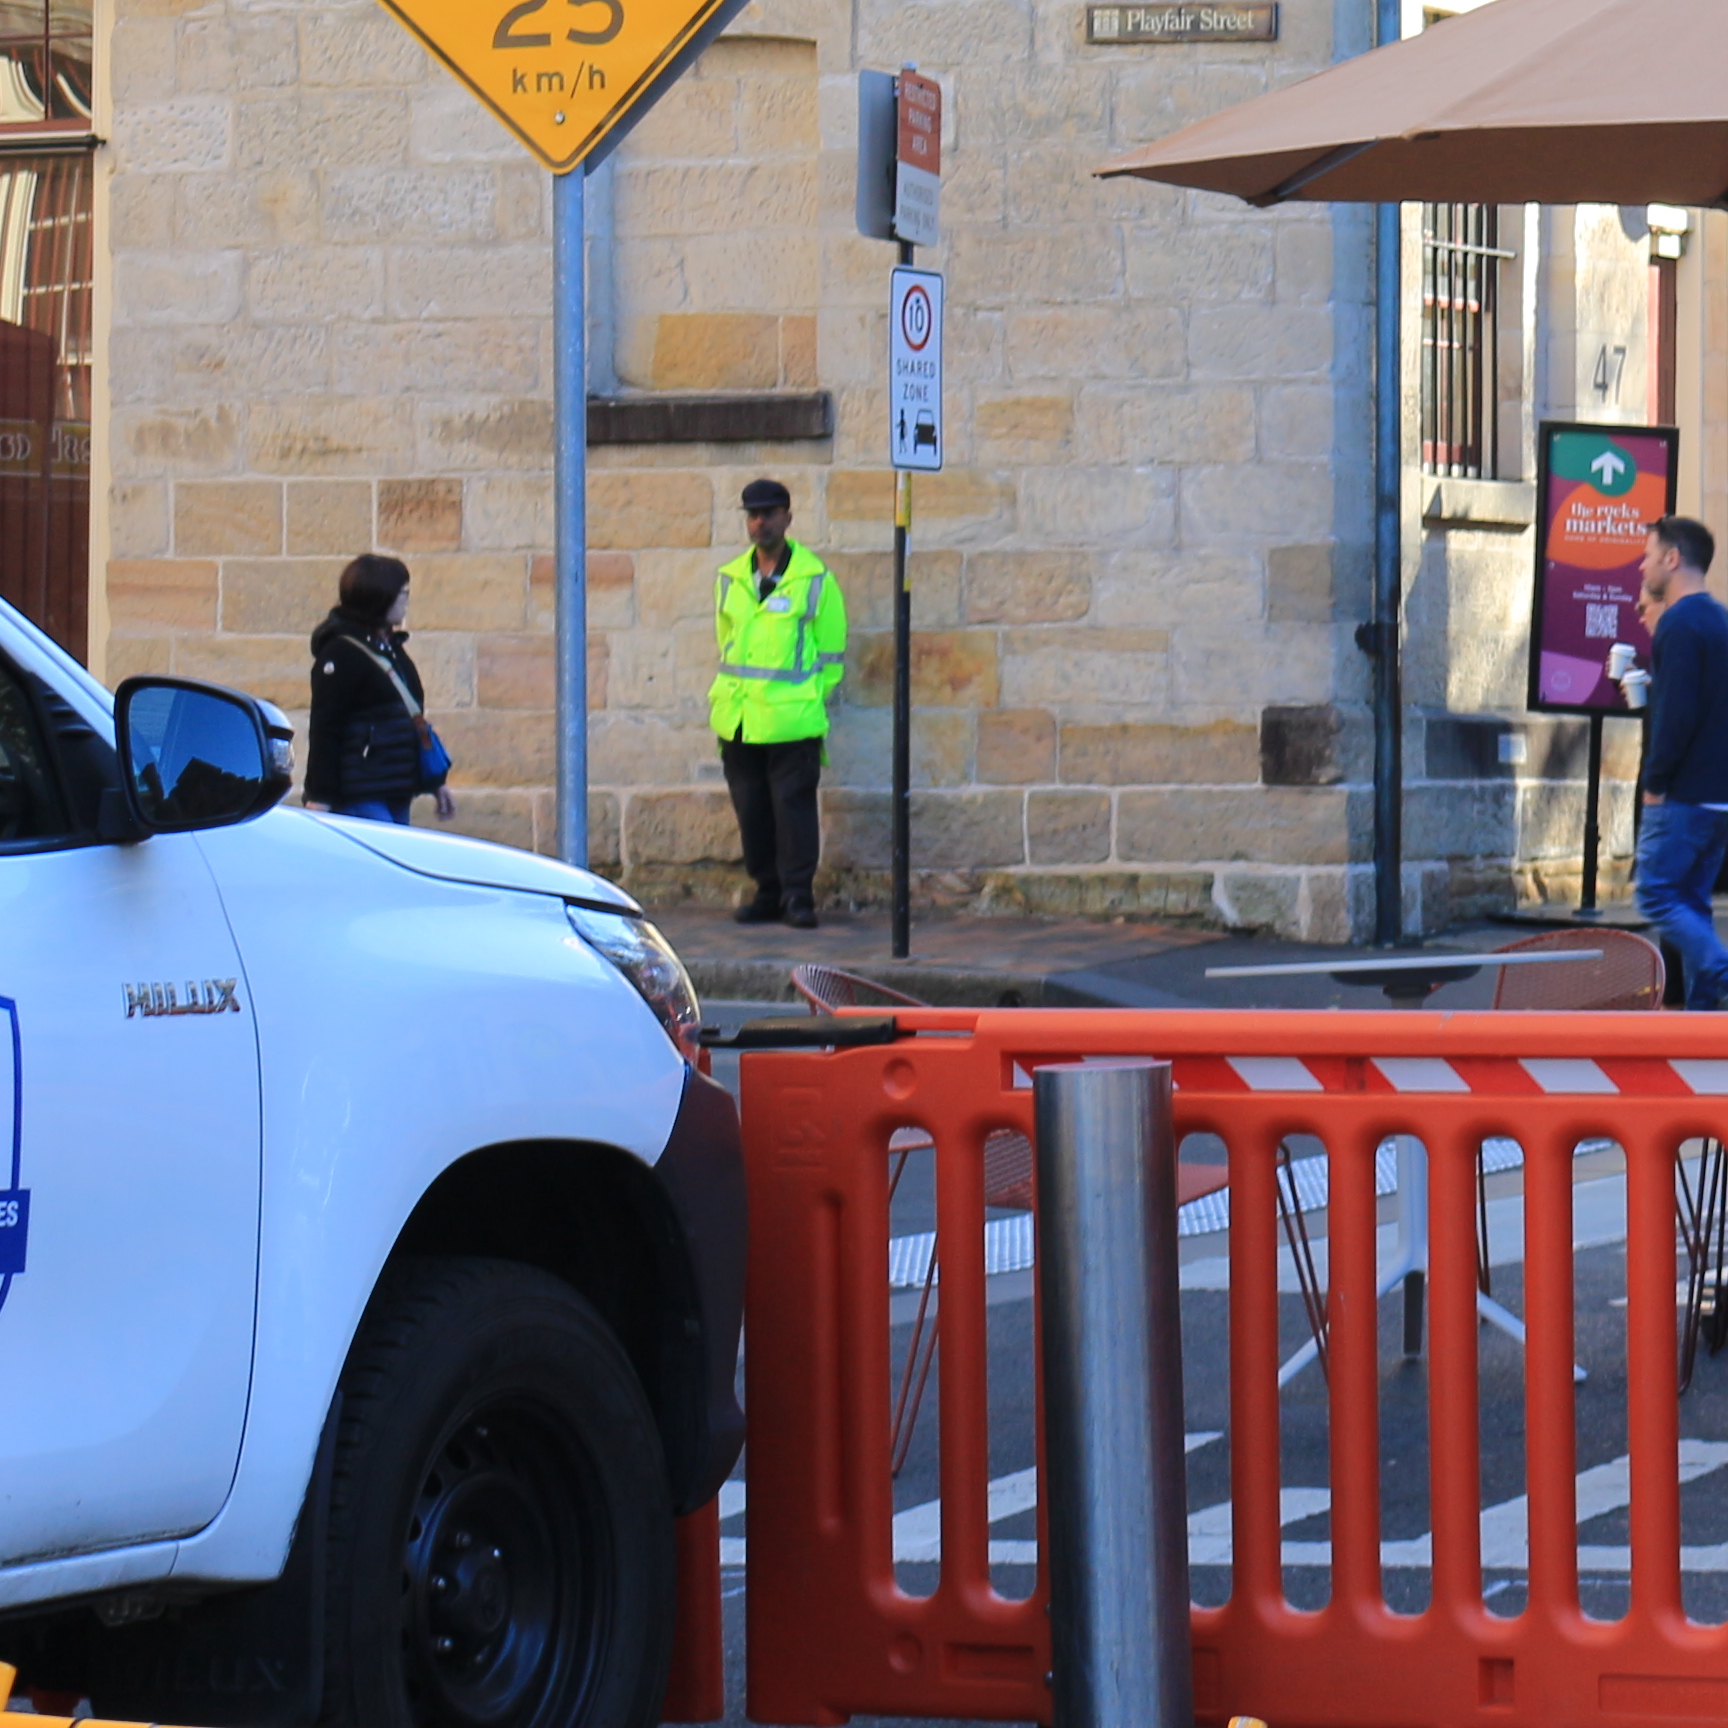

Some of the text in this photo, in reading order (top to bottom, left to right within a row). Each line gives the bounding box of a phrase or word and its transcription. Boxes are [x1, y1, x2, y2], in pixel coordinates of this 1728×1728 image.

[1126, 8, 1255, 35] Playfair Street
[512, 60, 607, 99] km/h
[908, 303, 925, 332] 10
[896, 358, 936, 379] SHARED
[1592, 343, 1627, 404] 47
[902, 383, 929, 403] ZONE
[1571, 502, 1640, 518] the rocks
[1566, 514, 1647, 535] markets
[122, 978, 240, 1018] HILUX
